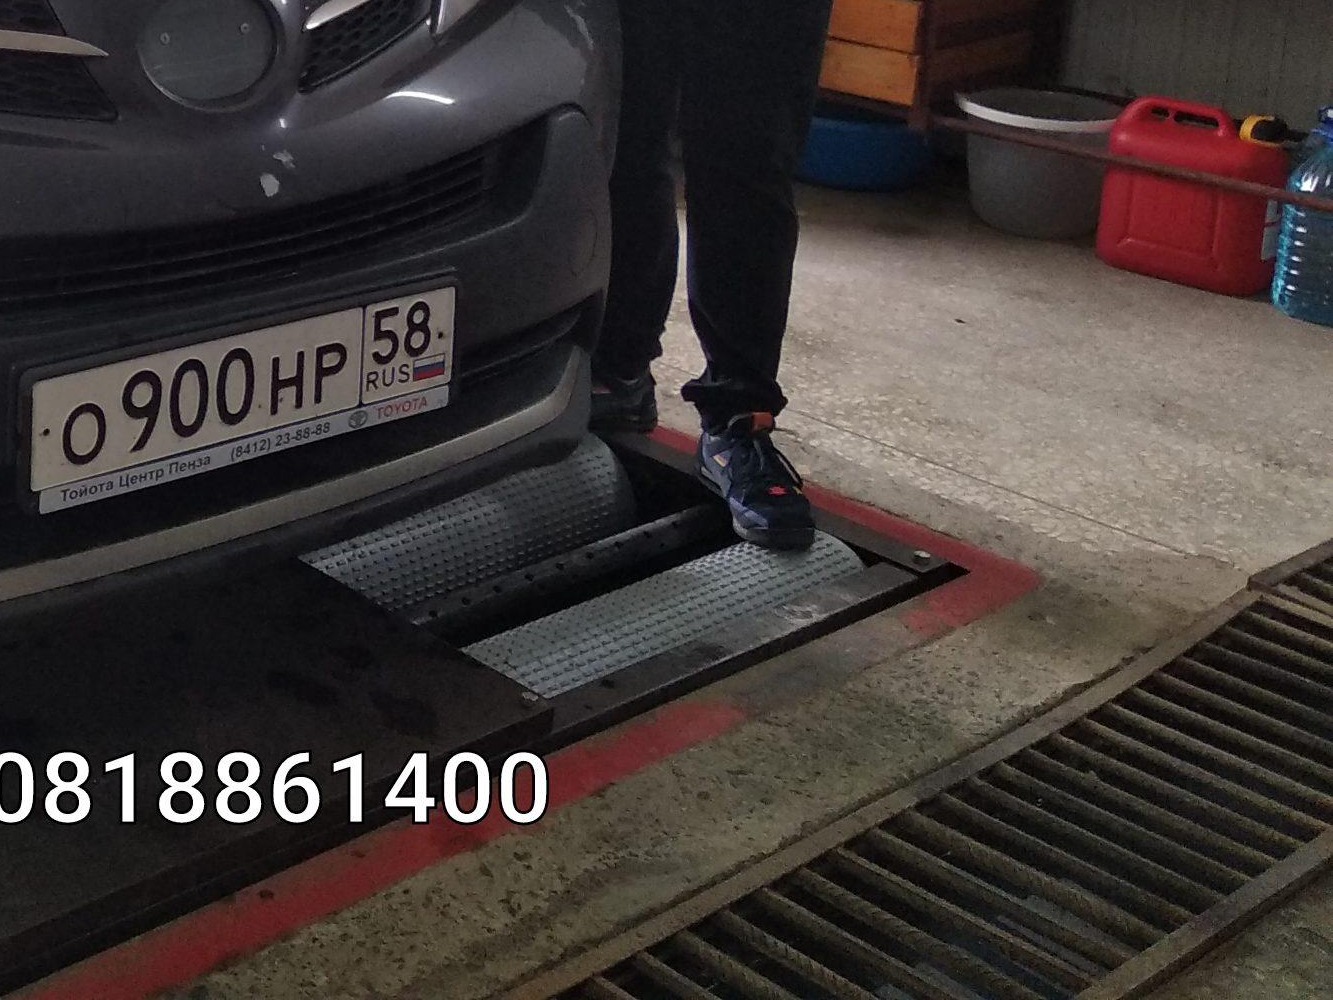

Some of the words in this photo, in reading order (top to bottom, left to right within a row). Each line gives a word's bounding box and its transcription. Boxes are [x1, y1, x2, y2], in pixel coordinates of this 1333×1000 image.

[371, 301, 431, 365] 58
[365, 364, 410, 392] RUS
[60, 480, 114, 502] Тойота
[119, 467, 165, 488] Центр
[168, 455, 211, 475] Пенза
[230, 438, 272, 462] (8412)
[275, 421, 332, 448] 23-88-88
[377, 396, 428, 420] TOYOTA
